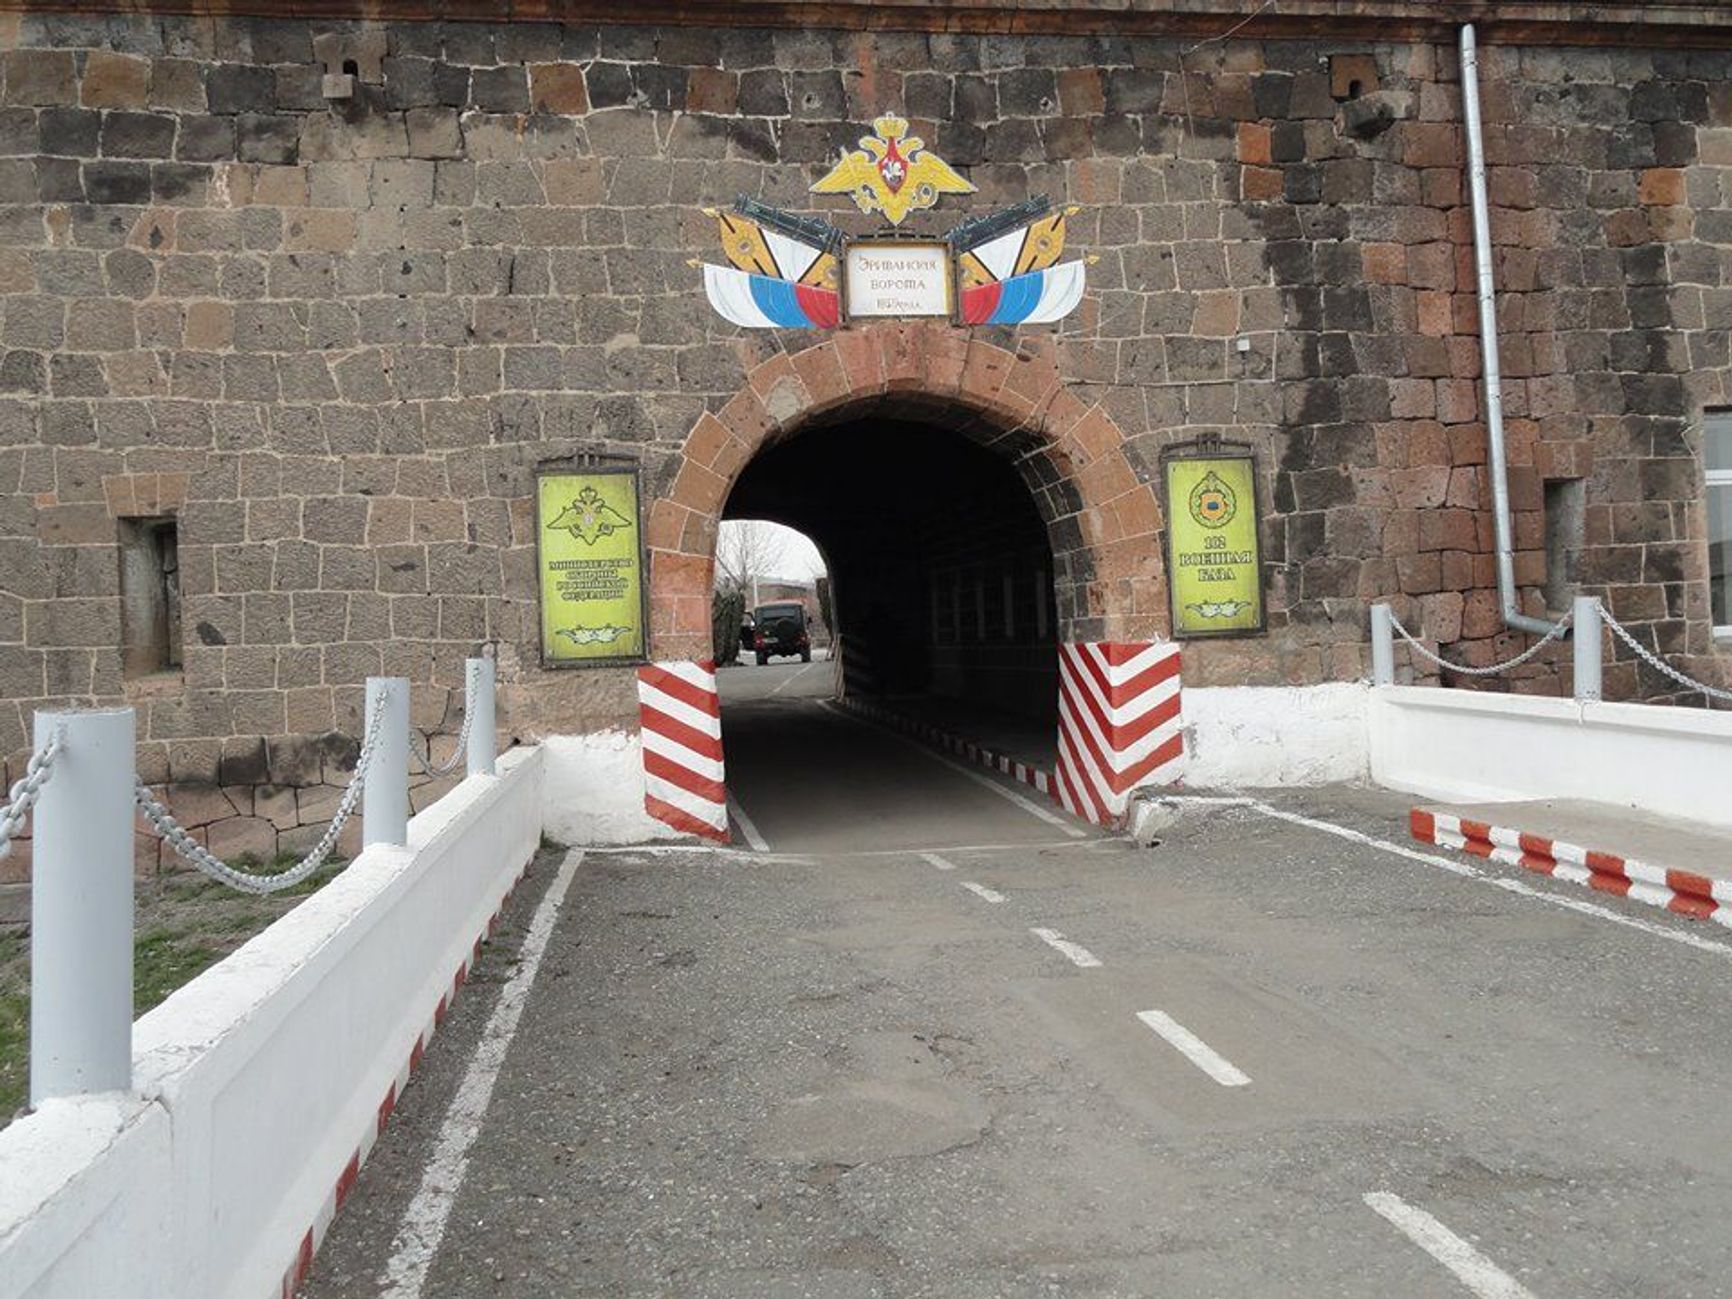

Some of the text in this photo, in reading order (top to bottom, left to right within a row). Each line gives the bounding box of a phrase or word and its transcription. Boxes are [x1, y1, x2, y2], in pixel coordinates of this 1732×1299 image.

[1204, 535, 1226, 550] 102
[1179, 551, 1253, 567] ВОЕННАЯ
[1198, 567, 1237, 582] БАЗА
